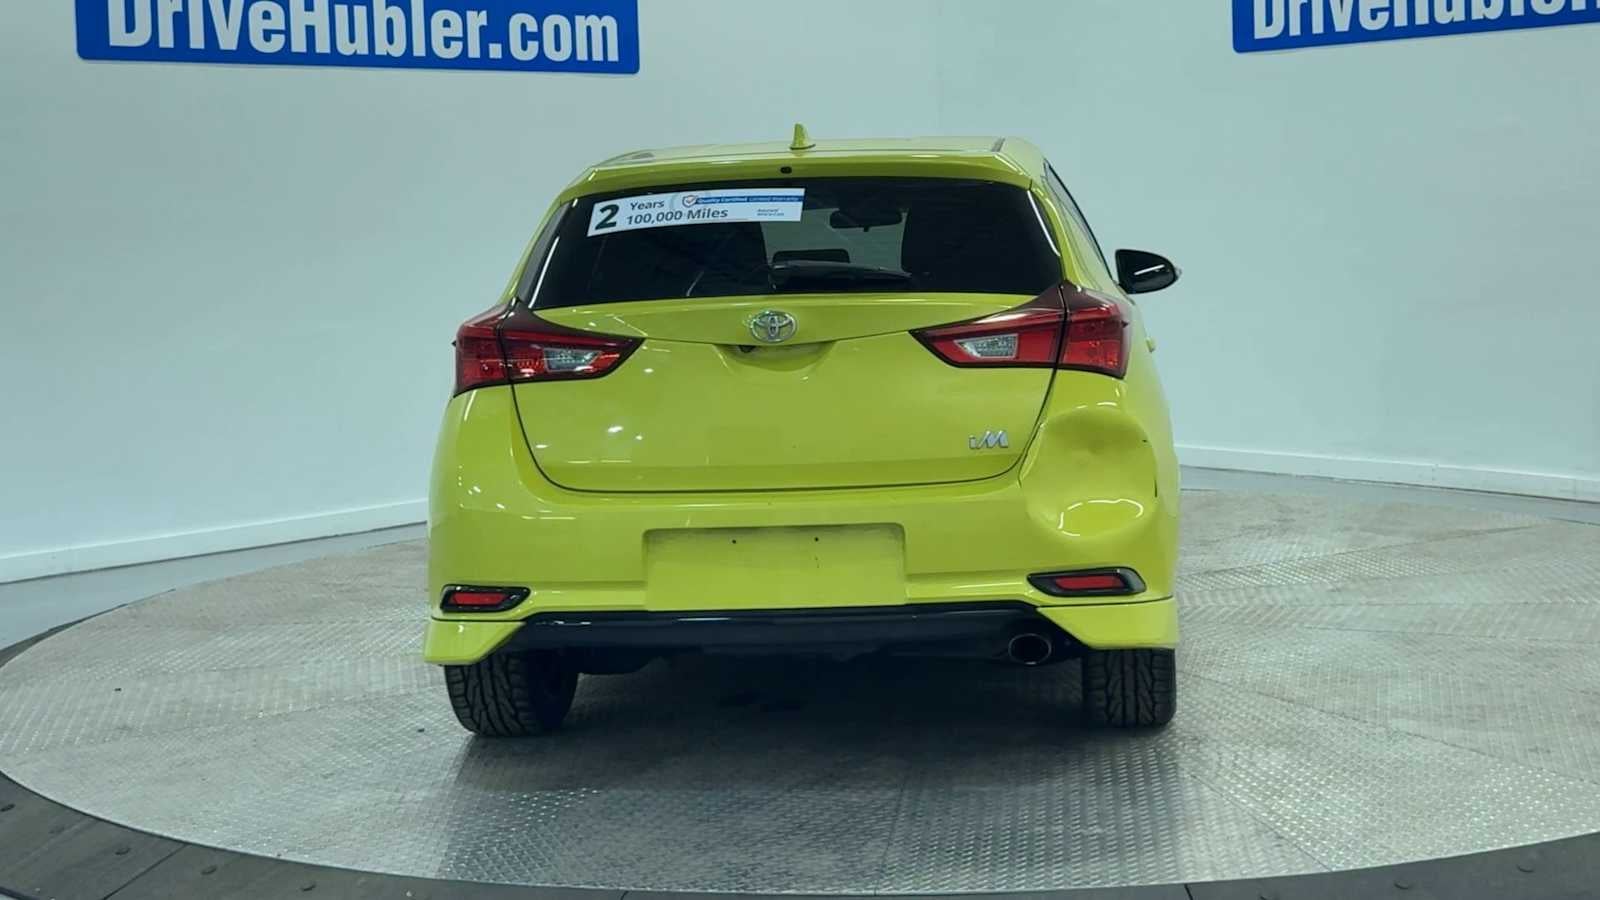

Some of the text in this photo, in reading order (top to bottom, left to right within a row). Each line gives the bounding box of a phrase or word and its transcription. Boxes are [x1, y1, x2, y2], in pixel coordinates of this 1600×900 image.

[108, 0, 620, 62] DriveHubler.com
[630, 199, 664, 211] Years
[595, 204, 619, 230] 2
[627, 208, 728, 225] 100,000 Miles
